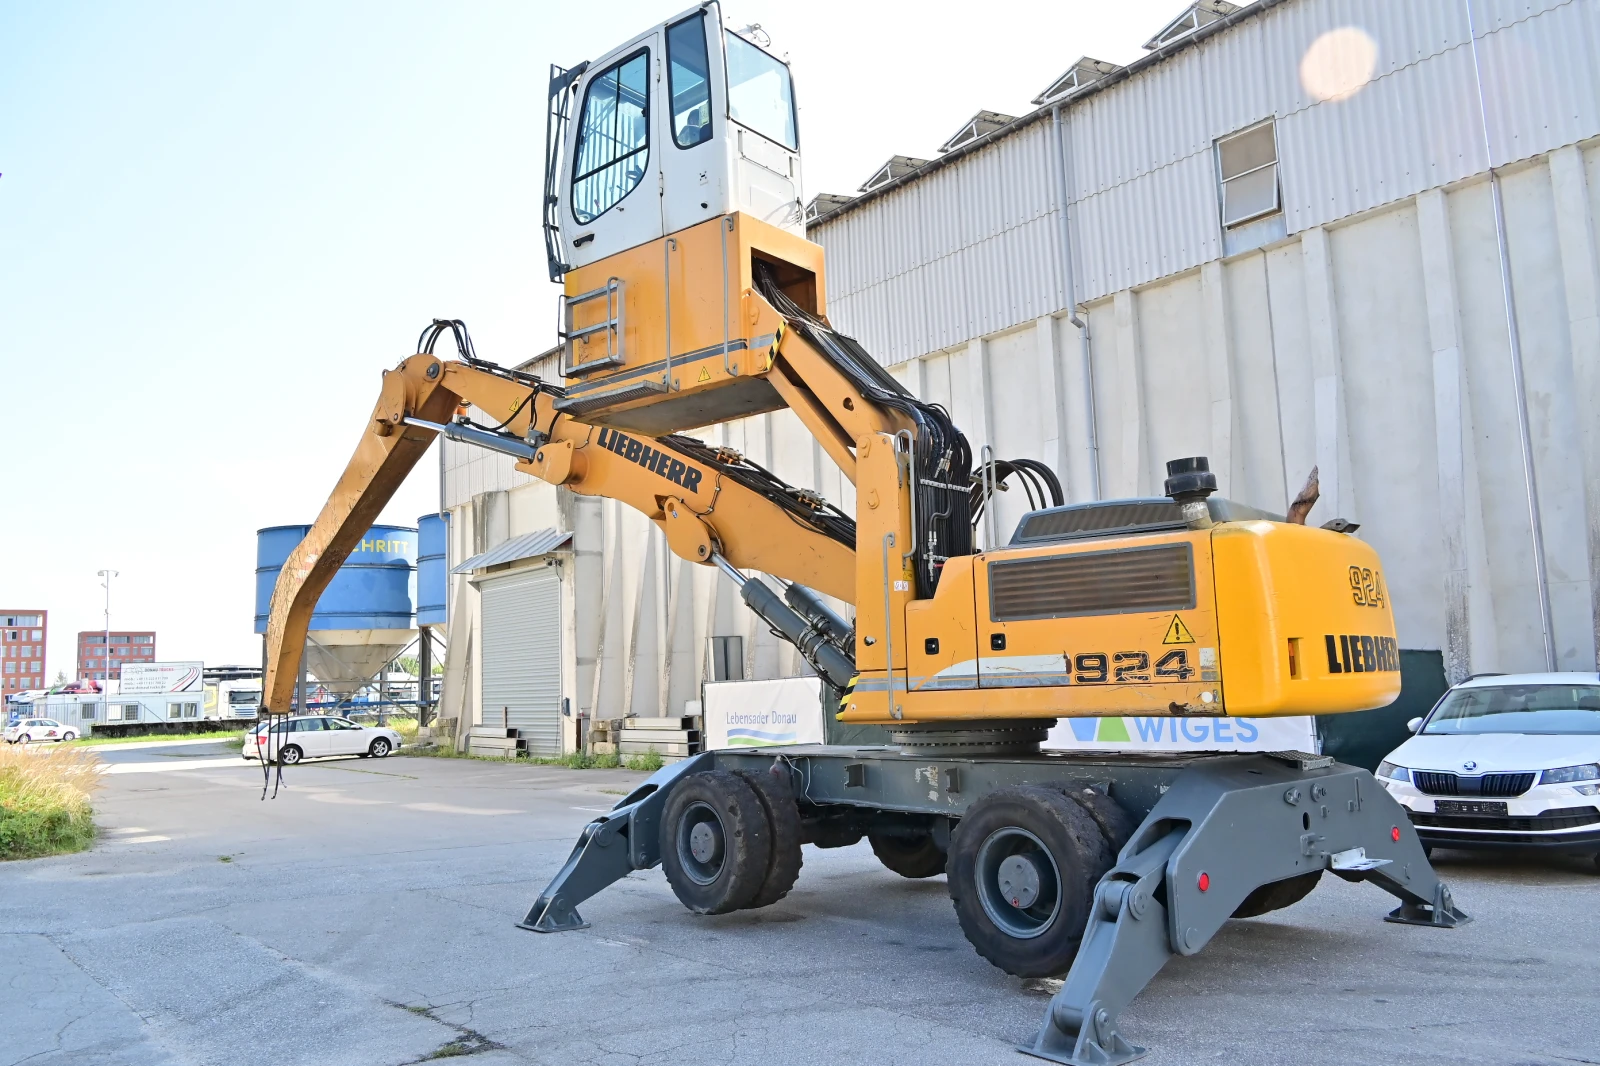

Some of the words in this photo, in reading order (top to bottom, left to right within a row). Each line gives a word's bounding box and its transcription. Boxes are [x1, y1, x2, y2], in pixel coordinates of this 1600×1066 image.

[597, 427, 703, 494] LIEBHERR
[353, 539, 409, 554] HRITT
[1349, 565, 1385, 608] 924
[1074, 648, 1196, 684] 924
[726, 711, 769, 725] Lebensader
[771, 711, 797, 724] Donau
[1133, 717, 1259, 743] WIGES
